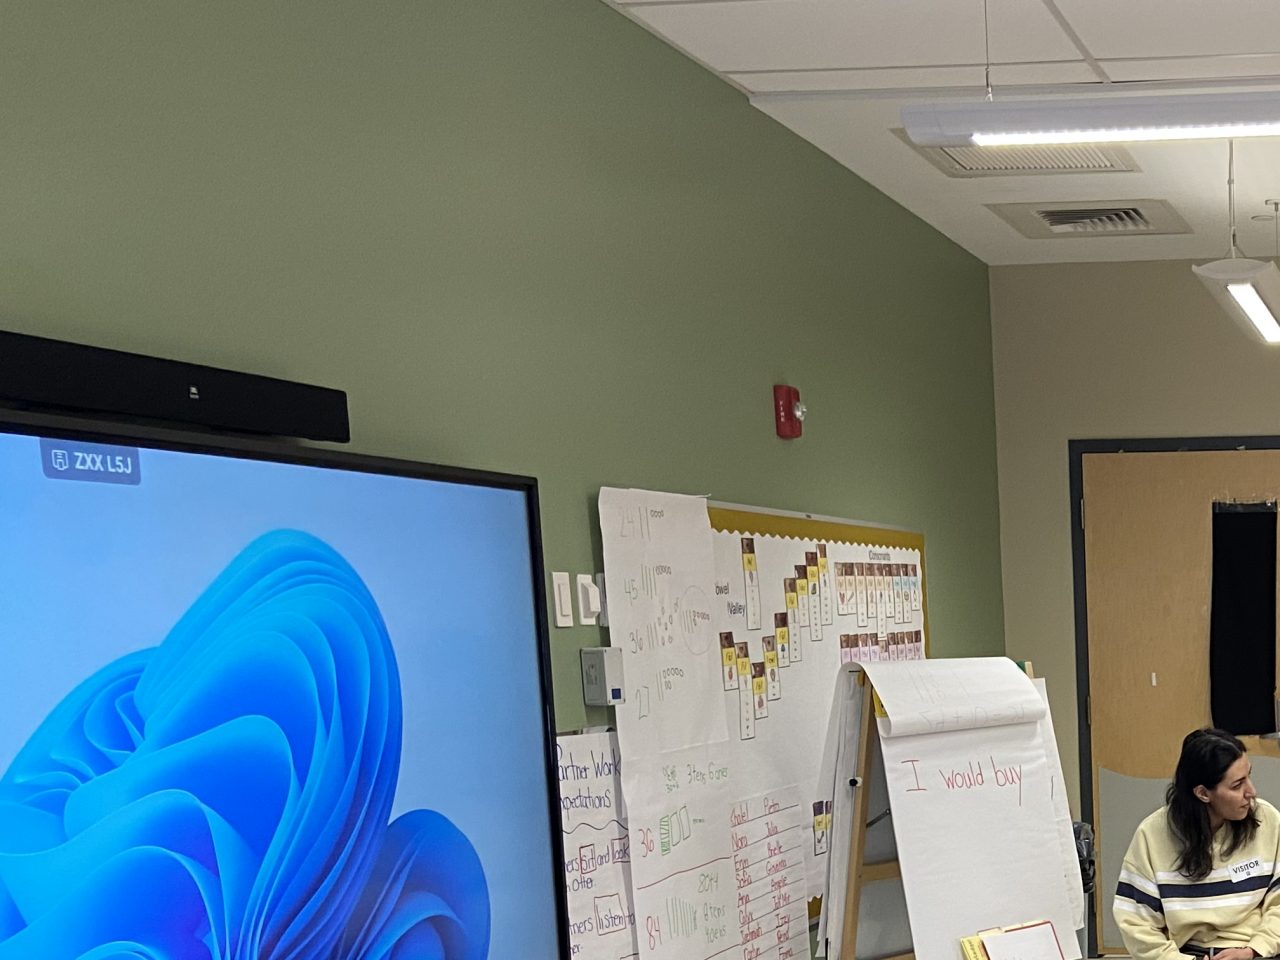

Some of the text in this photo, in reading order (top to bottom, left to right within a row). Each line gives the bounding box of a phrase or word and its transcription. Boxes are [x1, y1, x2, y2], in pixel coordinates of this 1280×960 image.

[74, 451, 133, 474] ZXX L5J
[624, 579, 639, 606] 45
[715, 582, 729, 596] owel
[591, 748, 621, 779] Work
[901, 755, 1022, 807] I would buy
[638, 827, 654, 857] 36
[597, 845, 609, 866] and
[1232, 860, 1259, 874] VISITOR
[596, 904, 623, 930] listen
[646, 916, 662, 950] 84
